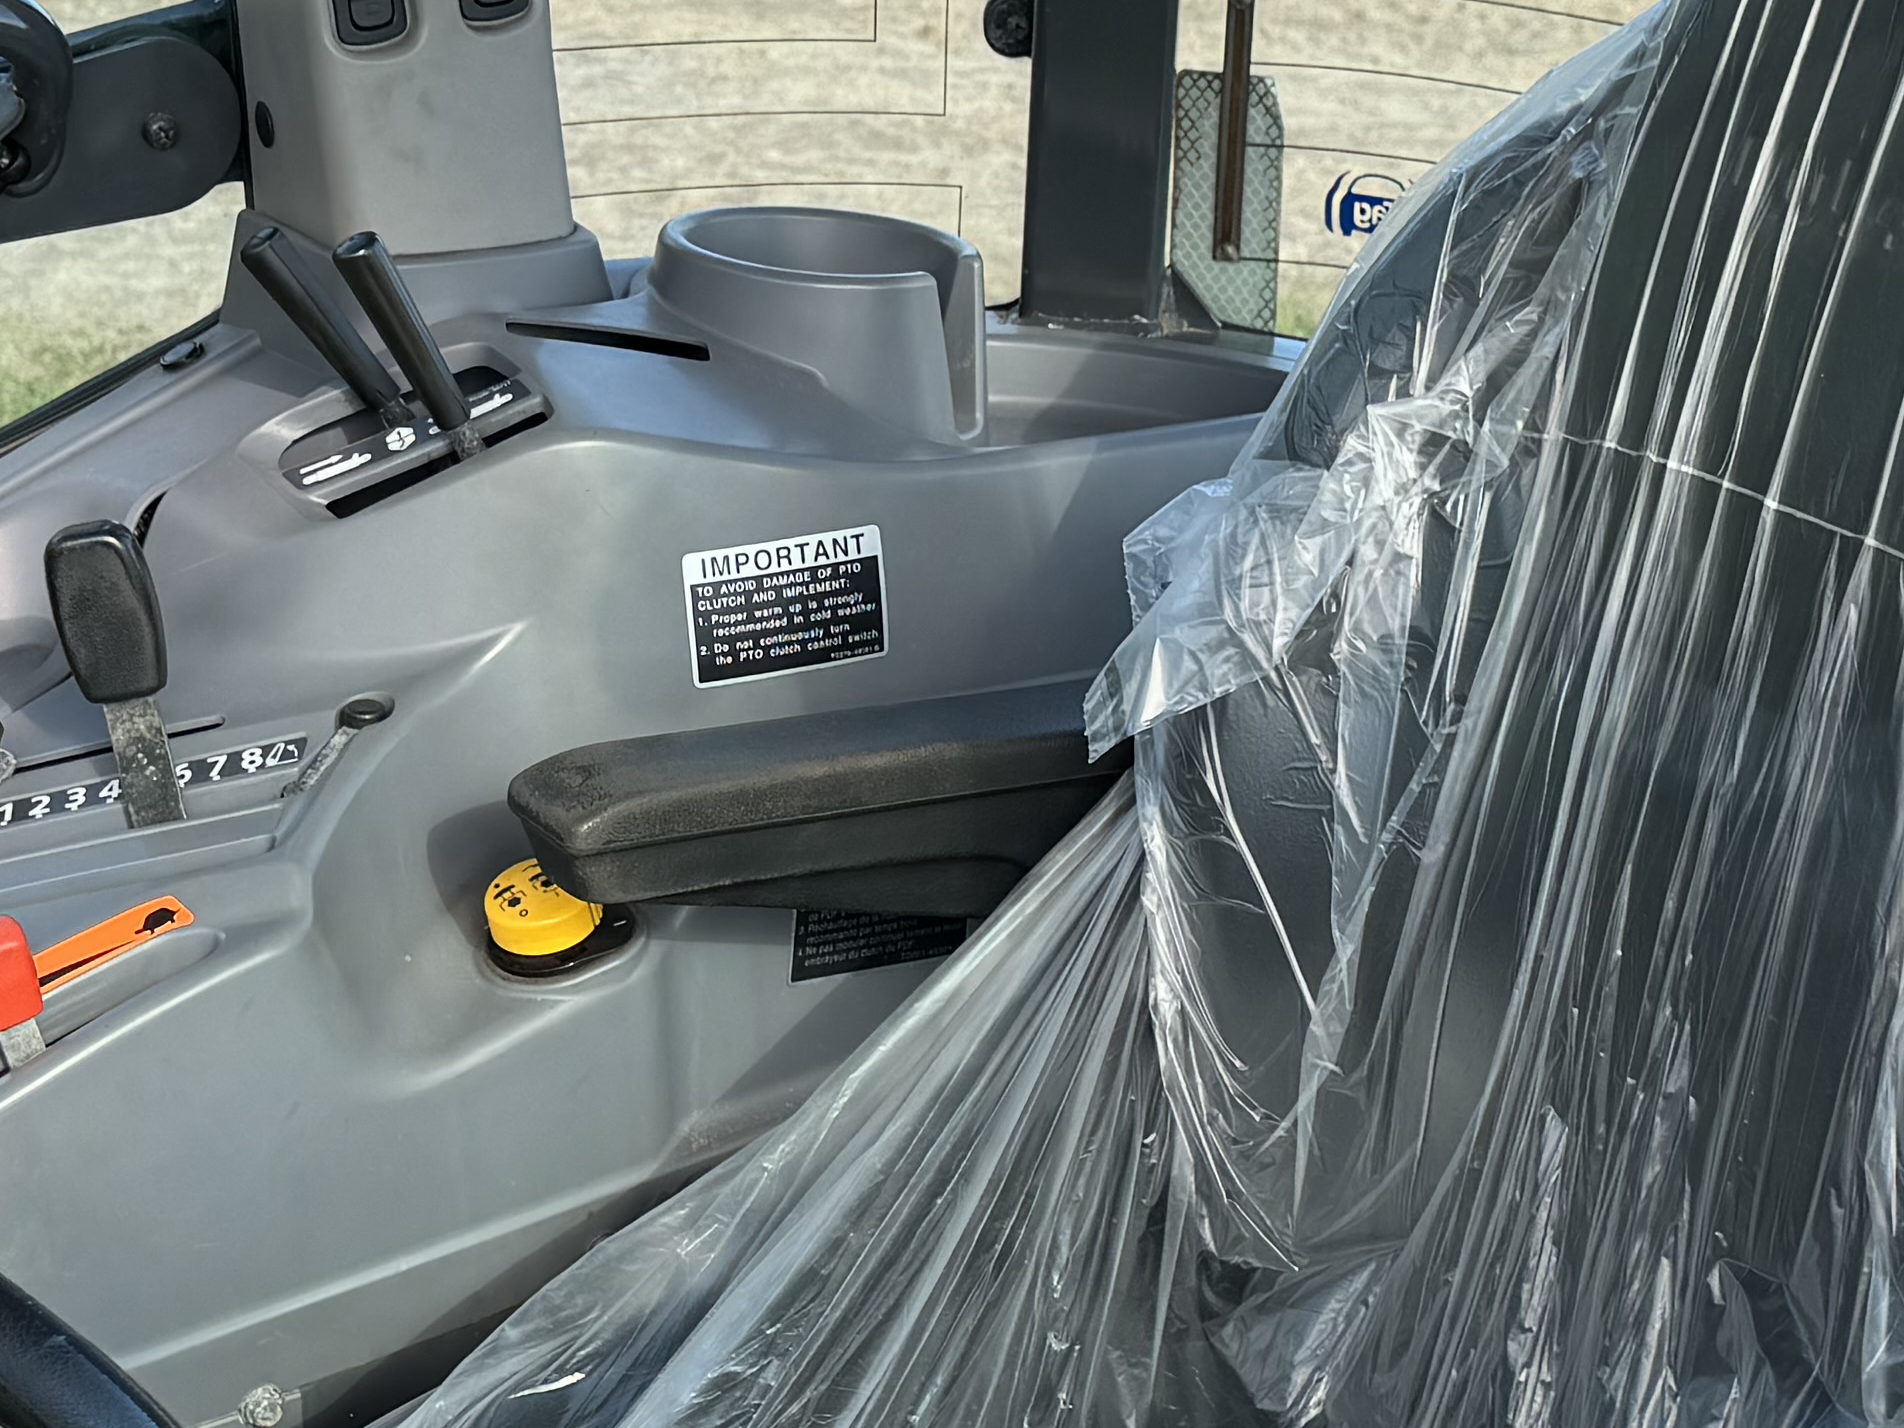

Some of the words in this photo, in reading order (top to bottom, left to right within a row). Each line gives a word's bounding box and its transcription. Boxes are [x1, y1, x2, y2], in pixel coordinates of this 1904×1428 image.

[700, 532, 865, 579] IMPORTANT
[696, 585, 713, 598] TO
[719, 578, 756, 595] AVOID
[762, 570, 811, 588] DAMAGE
[817, 567, 831, 579] OF
[838, 562, 861, 575] PTO
[697, 594, 745, 612] CLUTCH
[750, 589, 776, 603] AND
[782, 577, 850, 598] IMPLEMENT:
[697, 615, 708, 627] 1.
[710, 609, 748, 627] Proper
[753, 604, 782, 618] warm
[788, 601, 802, 614] up
[807, 598, 817, 609] is
[823, 591, 864, 609] strongly
[712, 616, 787, 638] recommended
[793, 613, 804, 624] in
[809, 608, 831, 621] cold
[837, 602, 876, 616] weather
[699, 645, 710, 656] 2.
[713, 642, 729, 654] Do
[735, 638, 753, 651] not
[759, 626, 824, 648] continuously
[829, 622, 850, 634] turn
[715, 654, 733, 666] the
[739, 648, 763, 662] PTO
[769, 642, 801, 657] clutch
[806, 635, 842, 650] control
[847, 628, 878, 643] switch
[28, 795, 51, 816] 2
[64, 787, 87, 809] 3
[99, 779, 122, 798] 4
[206, 754, 228, 778] 7
[241, 748, 264, 770] 8
